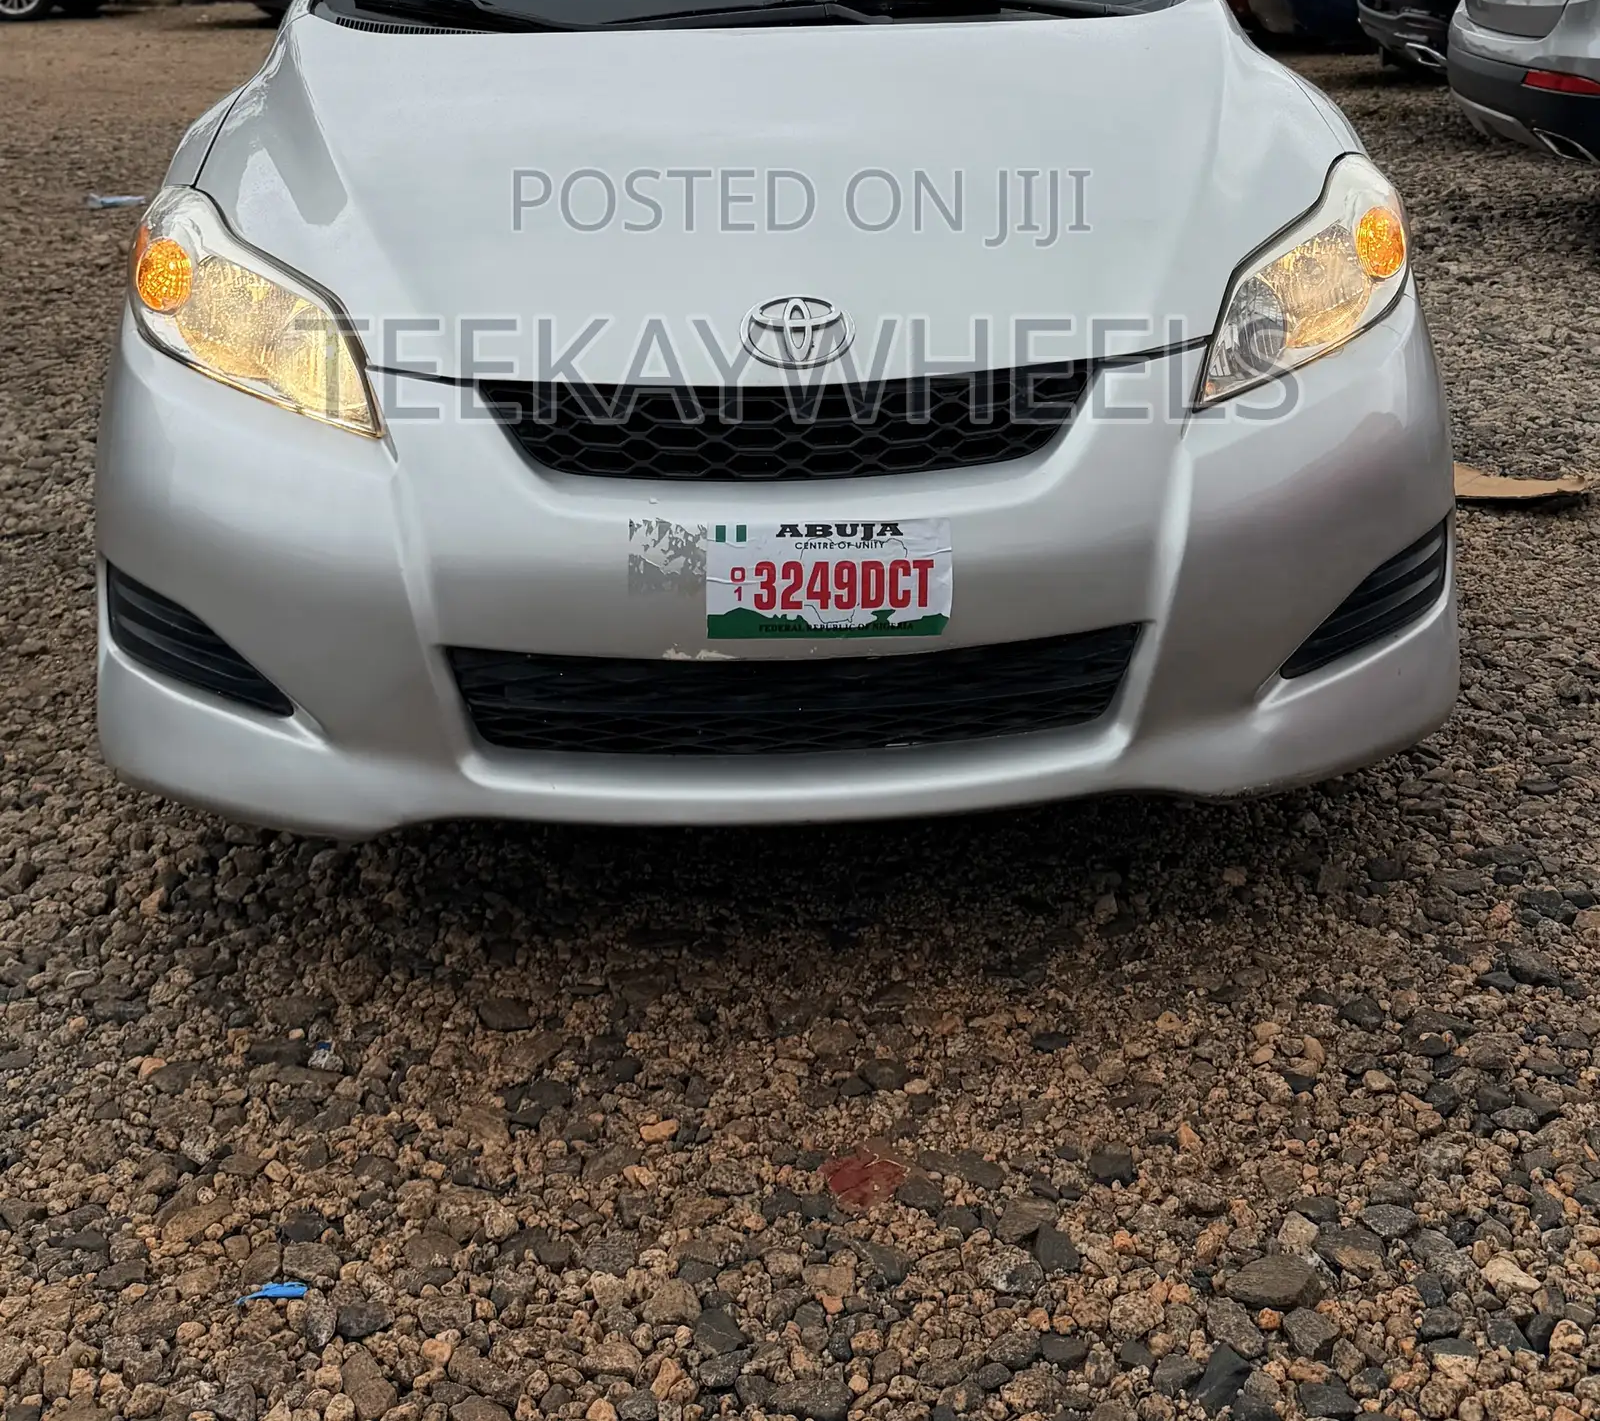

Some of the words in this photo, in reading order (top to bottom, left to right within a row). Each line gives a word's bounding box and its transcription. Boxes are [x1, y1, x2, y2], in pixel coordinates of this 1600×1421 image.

[776, 523, 904, 541] ABUJA
[794, 541, 835, 550] CENTRE
[837, 540, 853, 550] OF
[855, 540, 885, 550] UNITY
[753, 558, 935, 611] 3249DCT
[758, 623, 804, 633] FEDERAL
[806, 623, 856, 632] REPUBLIC
[857, 623, 870, 631] OF
[872, 621, 915, 631] NIGERIA
